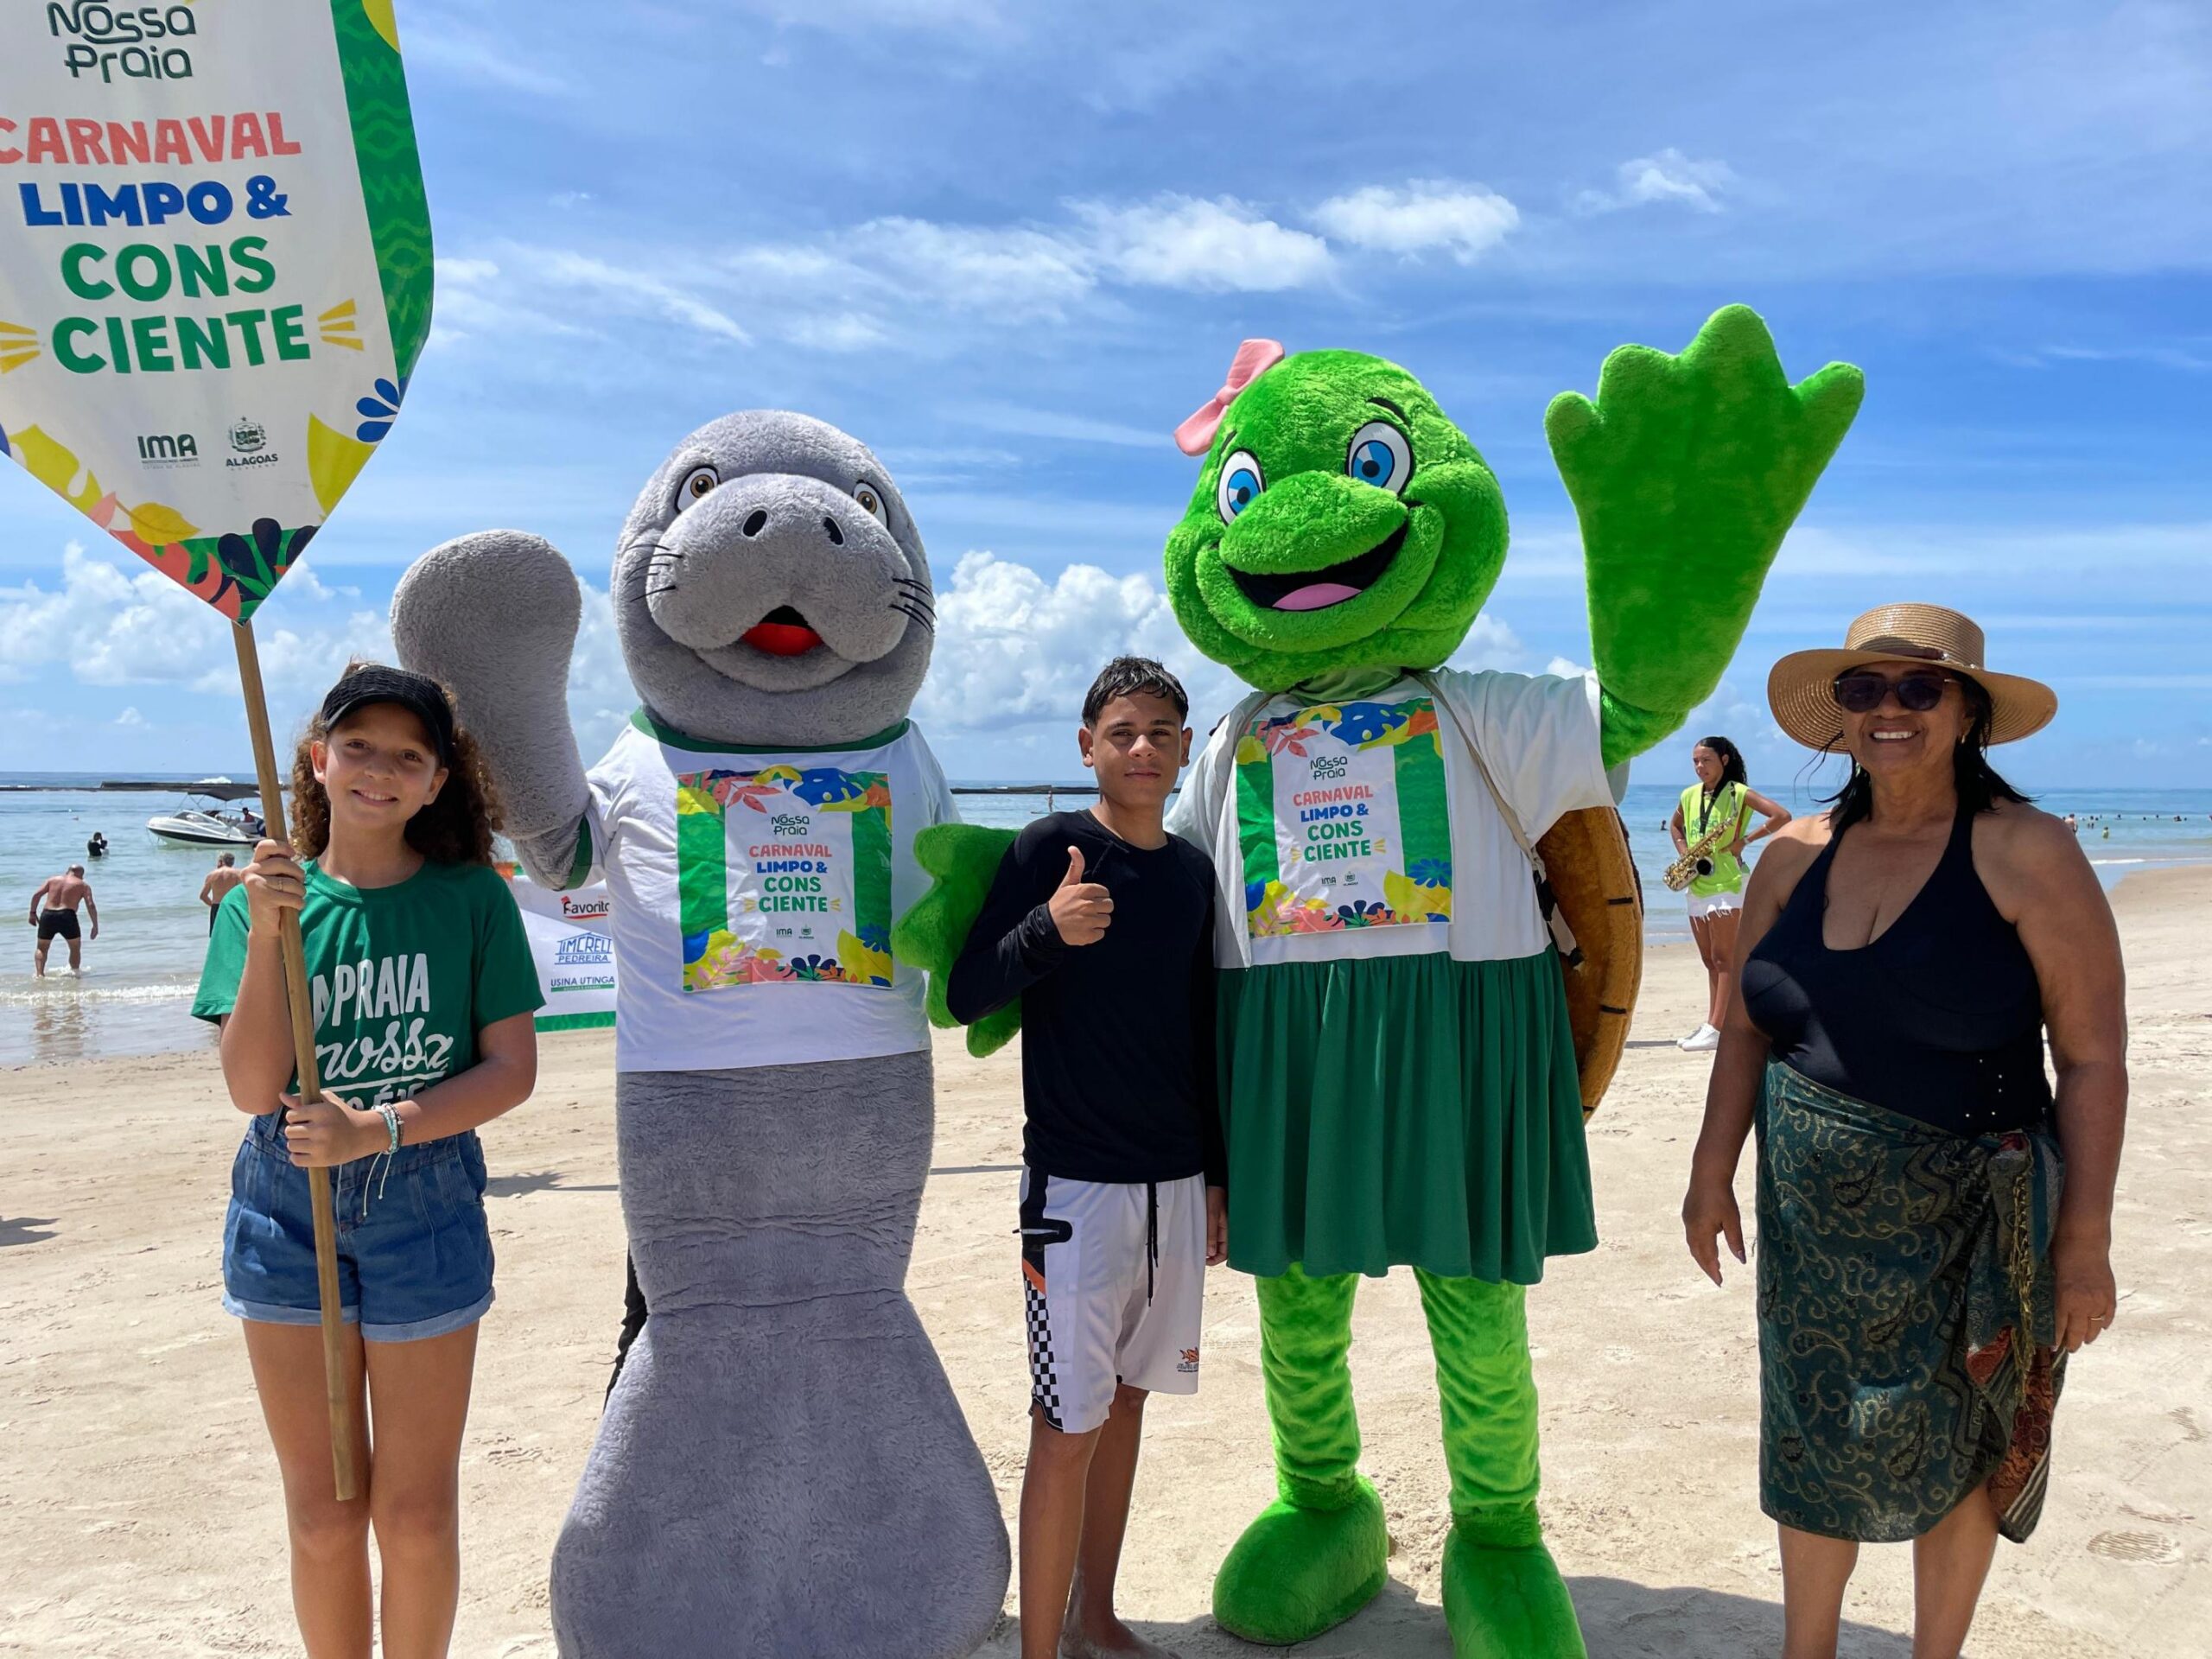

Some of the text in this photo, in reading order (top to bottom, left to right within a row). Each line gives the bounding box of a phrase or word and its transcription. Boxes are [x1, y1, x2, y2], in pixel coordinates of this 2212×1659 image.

[47, 0, 196, 44] Nossa
[64, 43, 194, 83] Praia
[18, 175, 293, 226] LIMPO &
[60, 236, 276, 302] CONS
[52, 304, 311, 373] CIENTE
[137, 434, 197, 459] IMA
[226, 454, 278, 467] ALAGOAS
[1310, 756, 1348, 770] Nossa
[1313, 767, 1345, 780] Praia
[1293, 785, 1373, 806] CARNAVAL
[771, 814, 810, 826] Nossa
[1300, 803, 1369, 823] LIMPO &
[773, 825, 808, 836] Praia
[1307, 820, 1363, 842] CONS
[748, 844, 833, 858] CARNAVAL
[1304, 839, 1371, 862] CIENTE
[756, 861, 828, 874] LIMPO &
[764, 876, 822, 893] CONS
[759, 896, 828, 912] CIENTE
[331, 953, 430, 1027] PRAIA
[550, 976, 615, 987] USINA UTINGA
